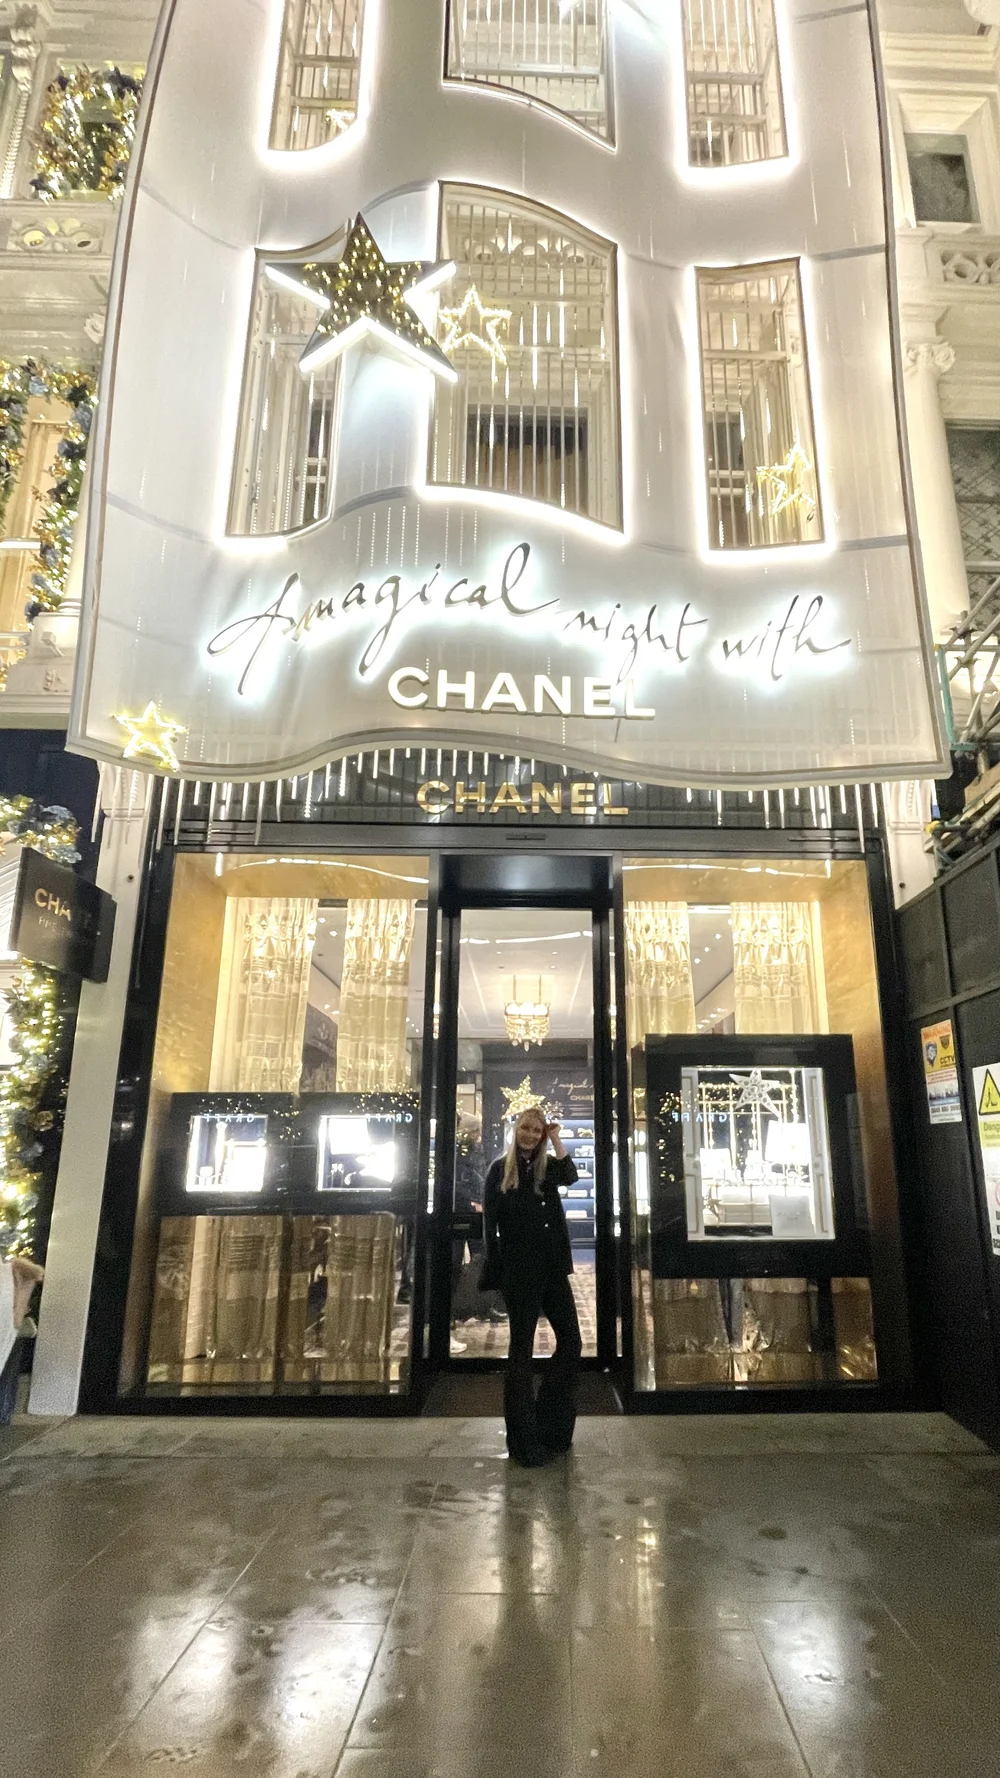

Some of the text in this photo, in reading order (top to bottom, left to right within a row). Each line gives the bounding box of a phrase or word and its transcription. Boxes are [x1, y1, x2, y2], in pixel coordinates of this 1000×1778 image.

[207, 542, 852, 695] A magical night with
[387, 666, 656, 720] CHANEL
[416, 780, 629, 815] CHANEL
[35, 888, 73, 921] CHA
